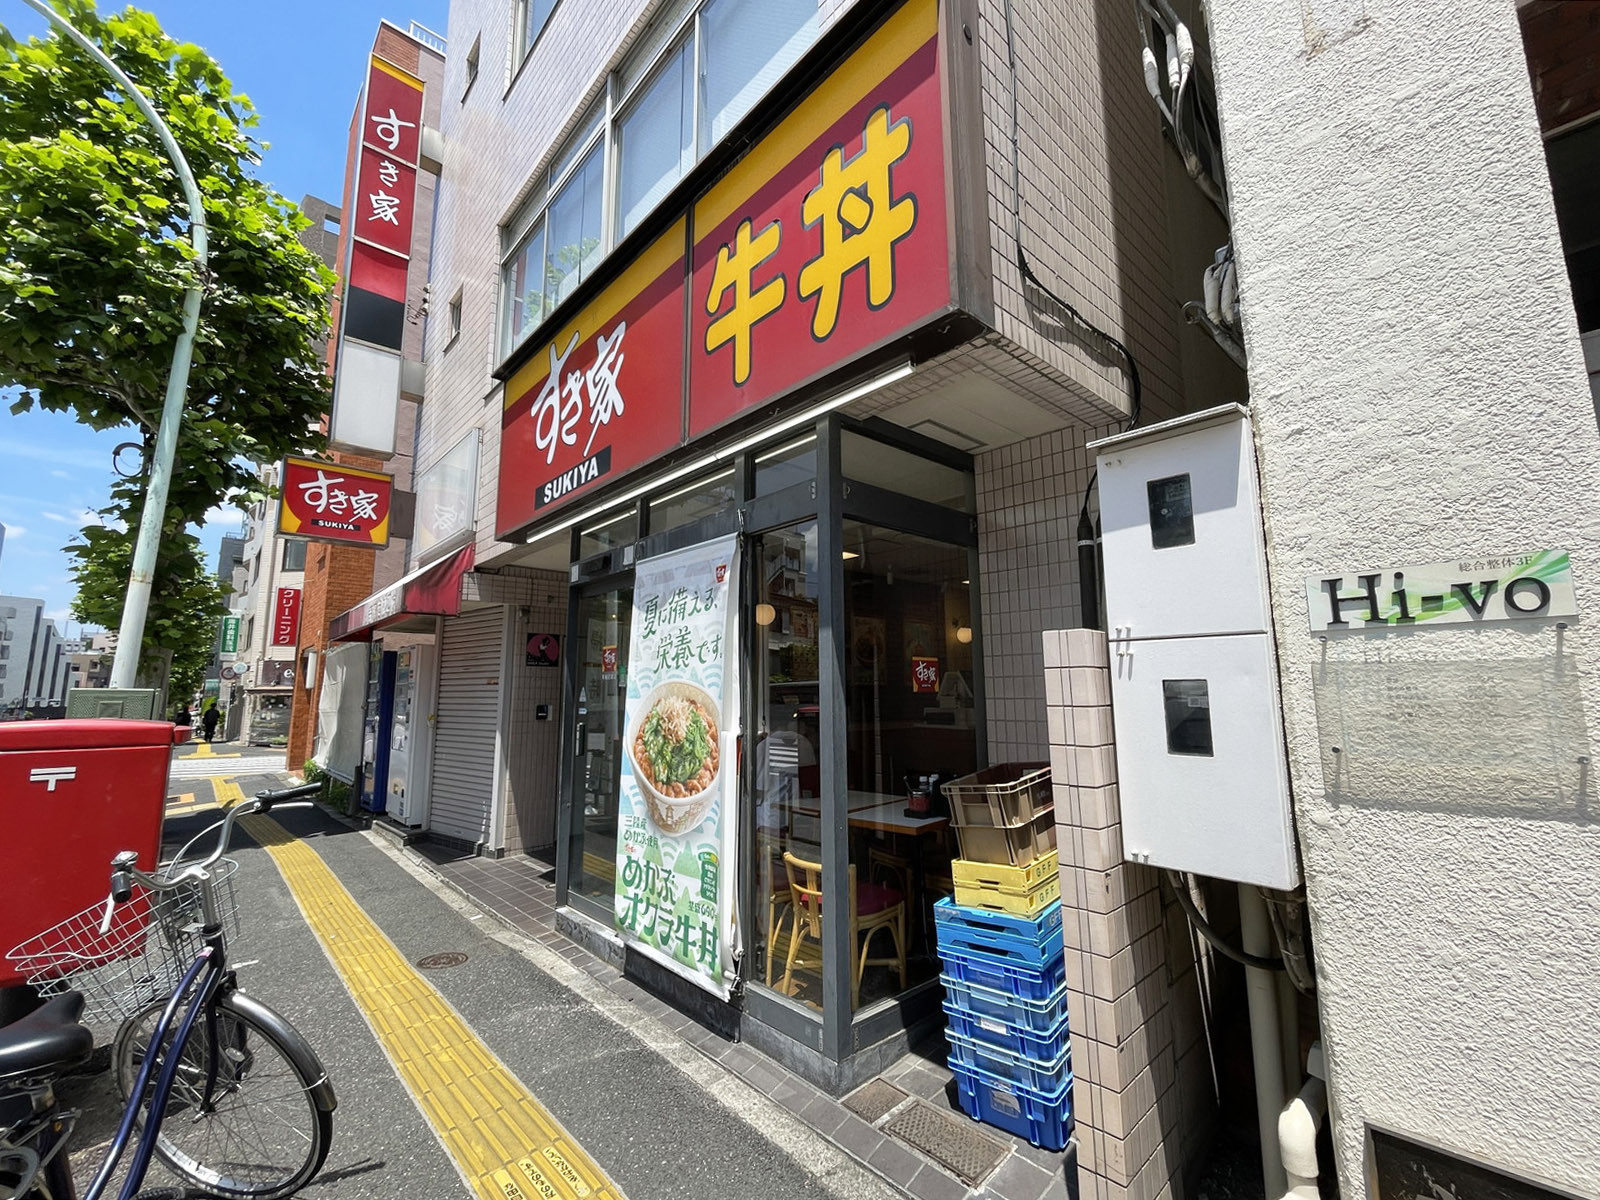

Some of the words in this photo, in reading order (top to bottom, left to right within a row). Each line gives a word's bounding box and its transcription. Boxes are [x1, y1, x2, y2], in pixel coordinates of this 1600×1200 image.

[370, 108, 416, 226] すき家
[705, 102, 917, 387] 牛丼
[531, 321, 625, 464] すき家
[298, 470, 378, 523] すき家
[543, 456, 599, 504] SUKIYA
[318, 520, 355, 531] SUKIYA
[1458, 555, 1533, 573] 総合整体3F
[279, 590, 295, 644] クリーニング
[622, 855, 676, 905] めかぶ
[1036, 860, 1052, 877] GFF
[1040, 885, 1055, 902] GFF
[619, 892, 718, 972] オクラ牛丼
